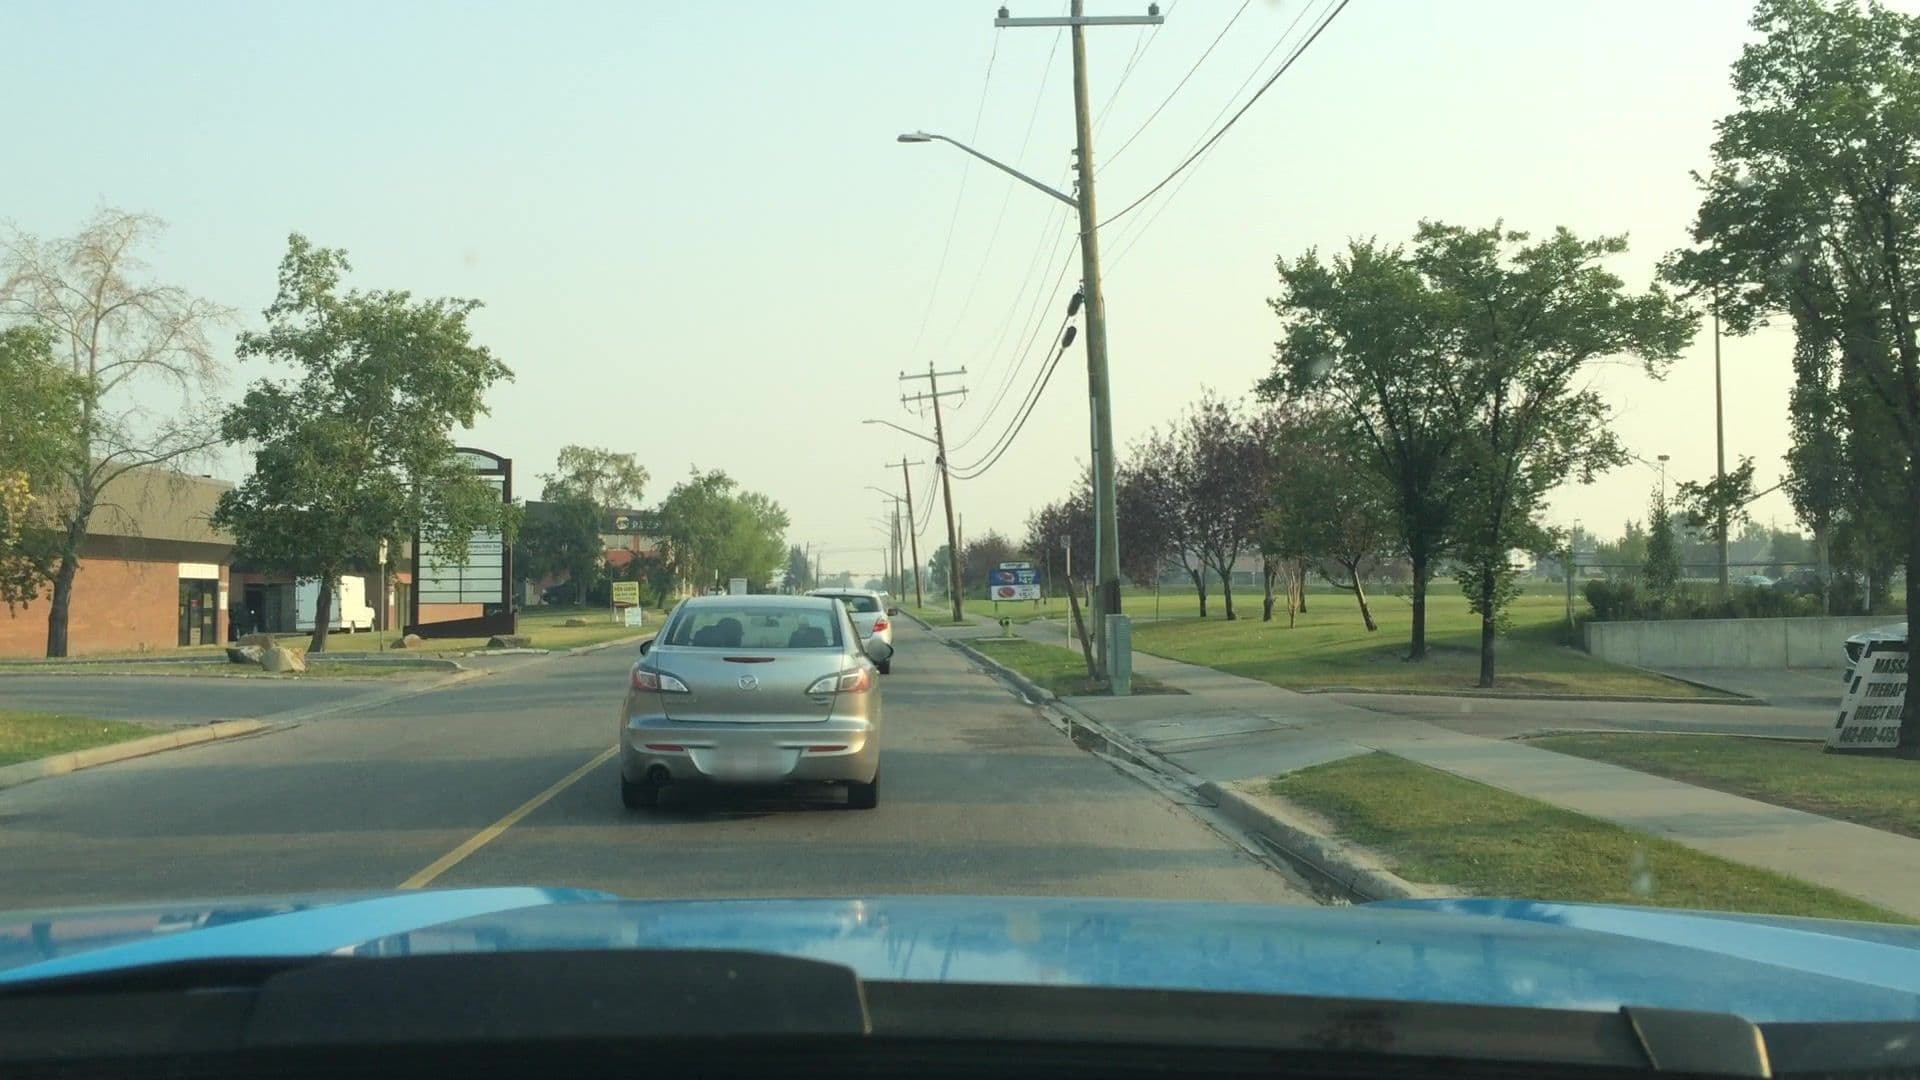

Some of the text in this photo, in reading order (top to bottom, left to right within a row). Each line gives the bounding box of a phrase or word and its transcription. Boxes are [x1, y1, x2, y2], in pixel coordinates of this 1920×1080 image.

[1872, 658, 1907, 674] MASS
[1865, 682, 1907, 698] THERAP
[1853, 705, 1887, 721] DIRECT
